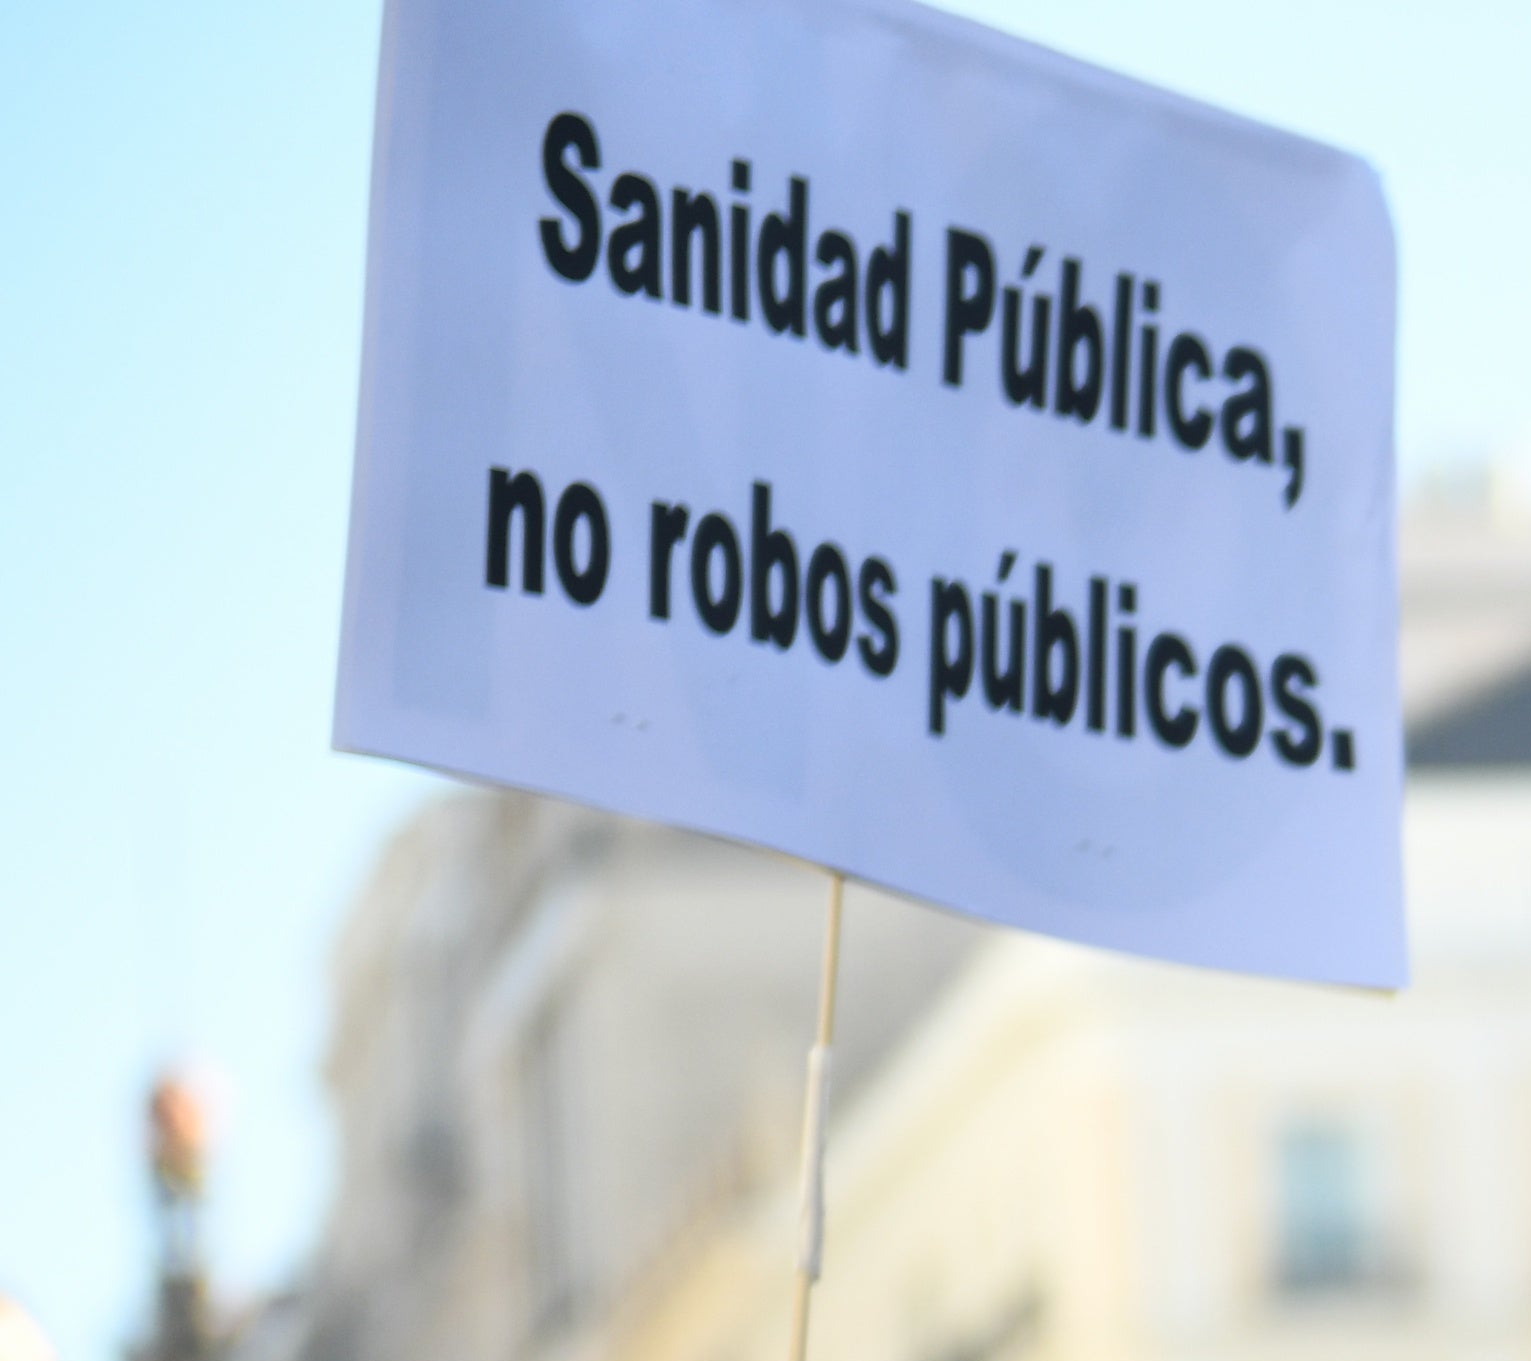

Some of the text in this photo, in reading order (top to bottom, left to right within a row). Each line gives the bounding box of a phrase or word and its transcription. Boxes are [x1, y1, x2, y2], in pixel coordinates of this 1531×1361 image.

[536, 110, 1305, 509] Sanidad Pública,
[484, 466, 1355, 772] no robos públicos.
